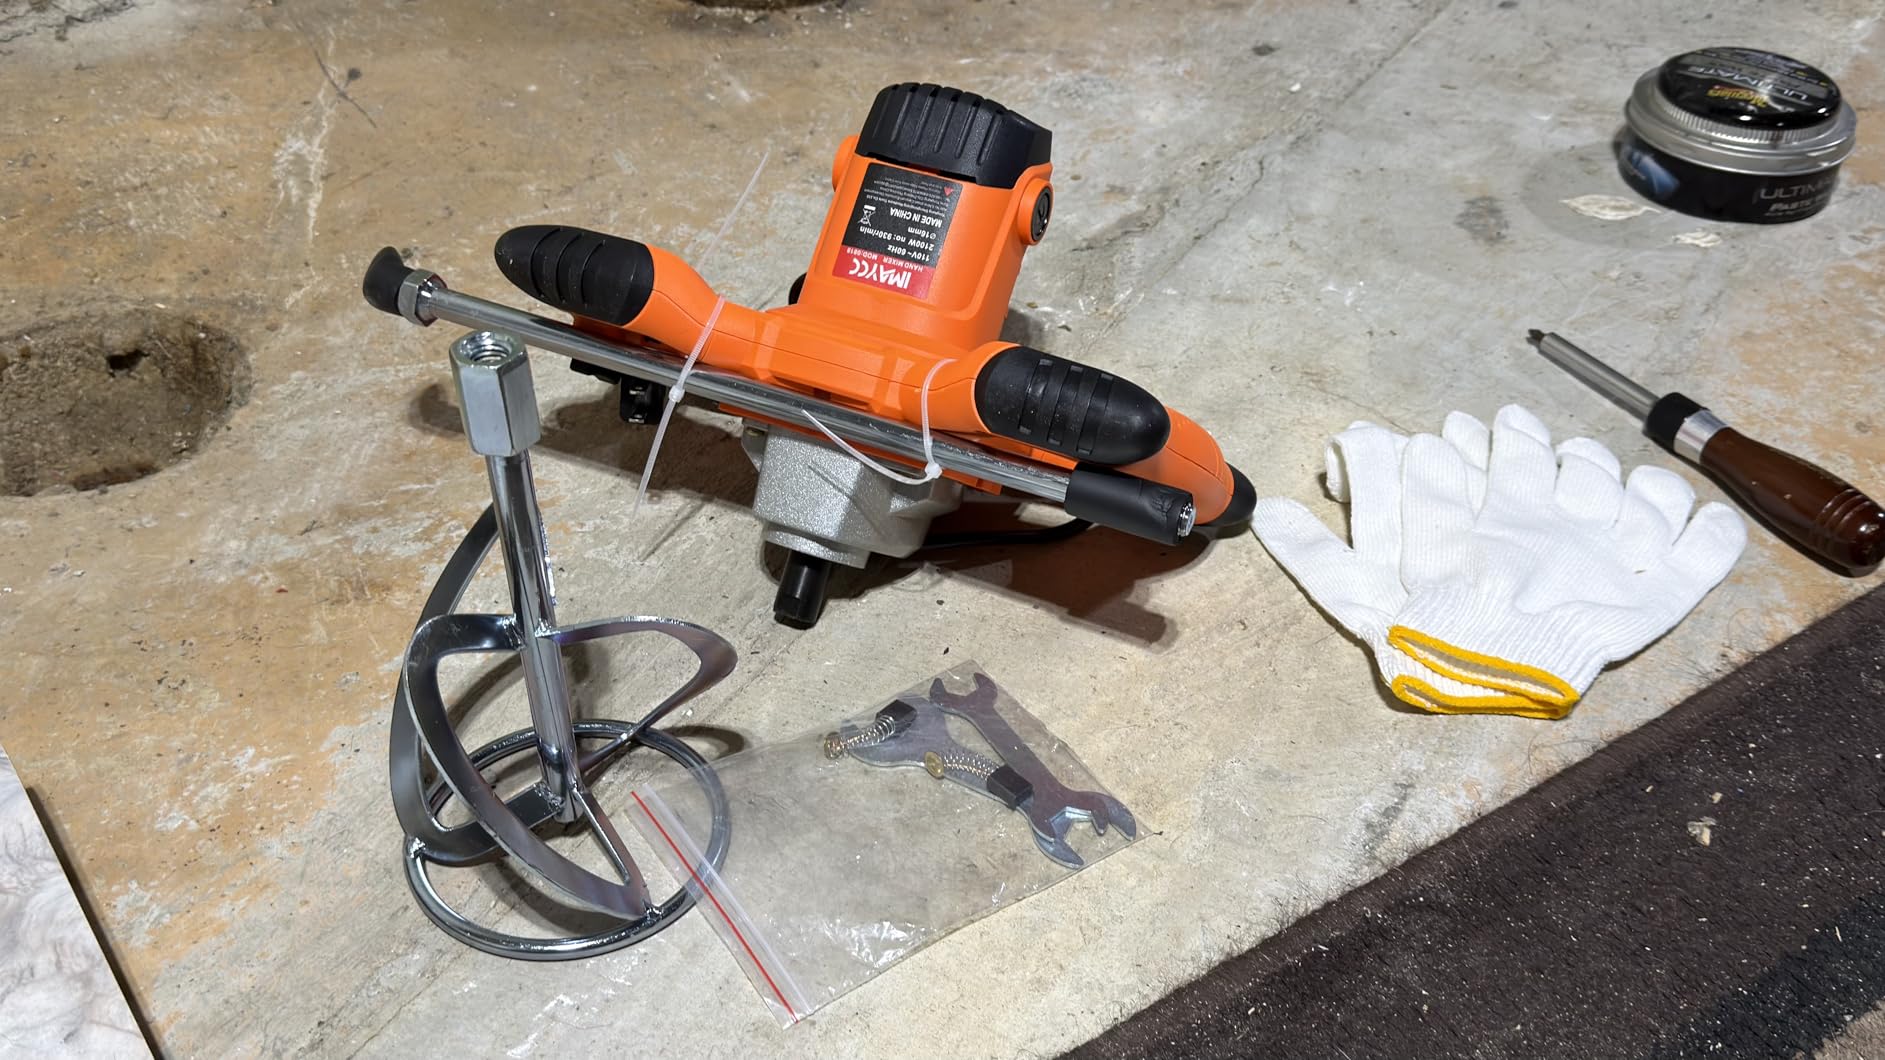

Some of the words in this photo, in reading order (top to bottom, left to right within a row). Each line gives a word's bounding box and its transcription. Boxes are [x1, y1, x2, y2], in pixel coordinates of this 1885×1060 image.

[890, 207, 912, 220] CHINA
[912, 213, 921, 222] IN
[920, 215, 943, 228] MADE
[859, 226, 892, 241] 930r/min
[887, 244, 907, 256] 60Hz
[908, 238, 935, 251] 2100W
[883, 257, 904, 267] MIXER
[904, 262, 924, 272] HAND
[849, 258, 912, 289] IMAYCC
